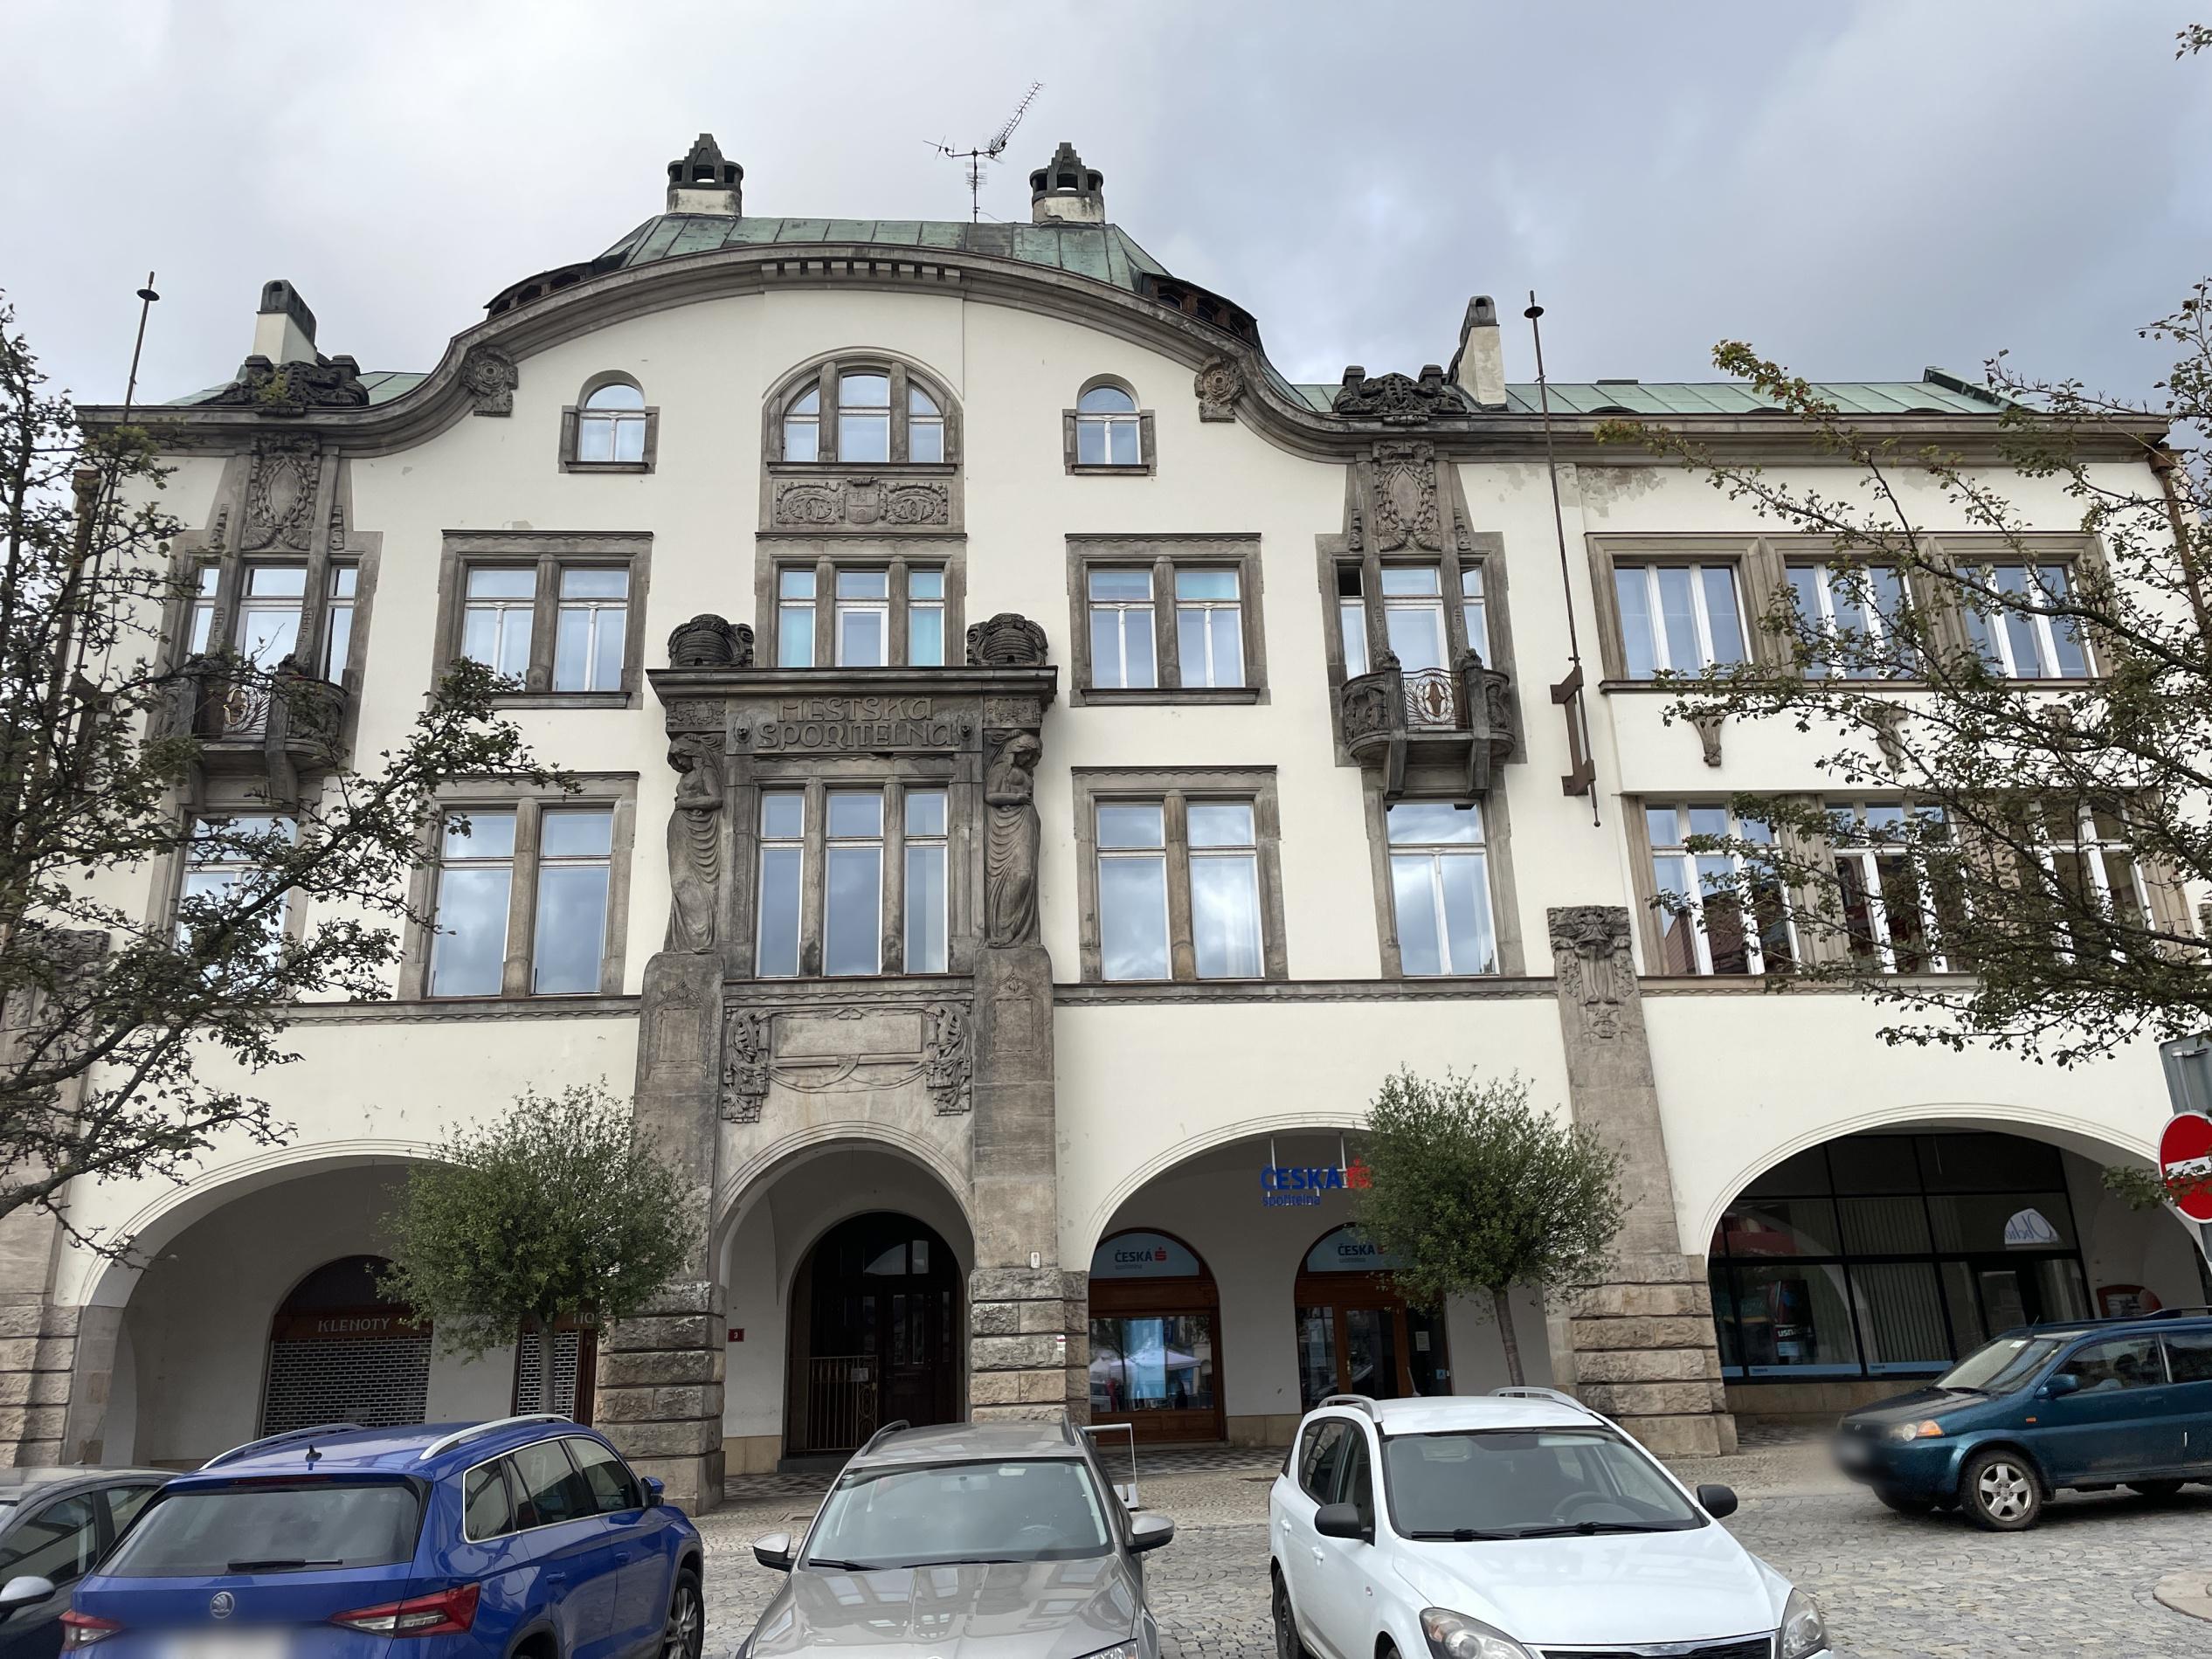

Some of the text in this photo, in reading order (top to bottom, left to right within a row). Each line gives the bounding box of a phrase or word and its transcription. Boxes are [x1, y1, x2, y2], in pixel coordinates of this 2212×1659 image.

[1261, 1163, 1343, 1190] ČESKÁ
[1114, 1248, 1152, 1263] ČESKÁ
[317, 1317, 391, 1332] KLENOTY
